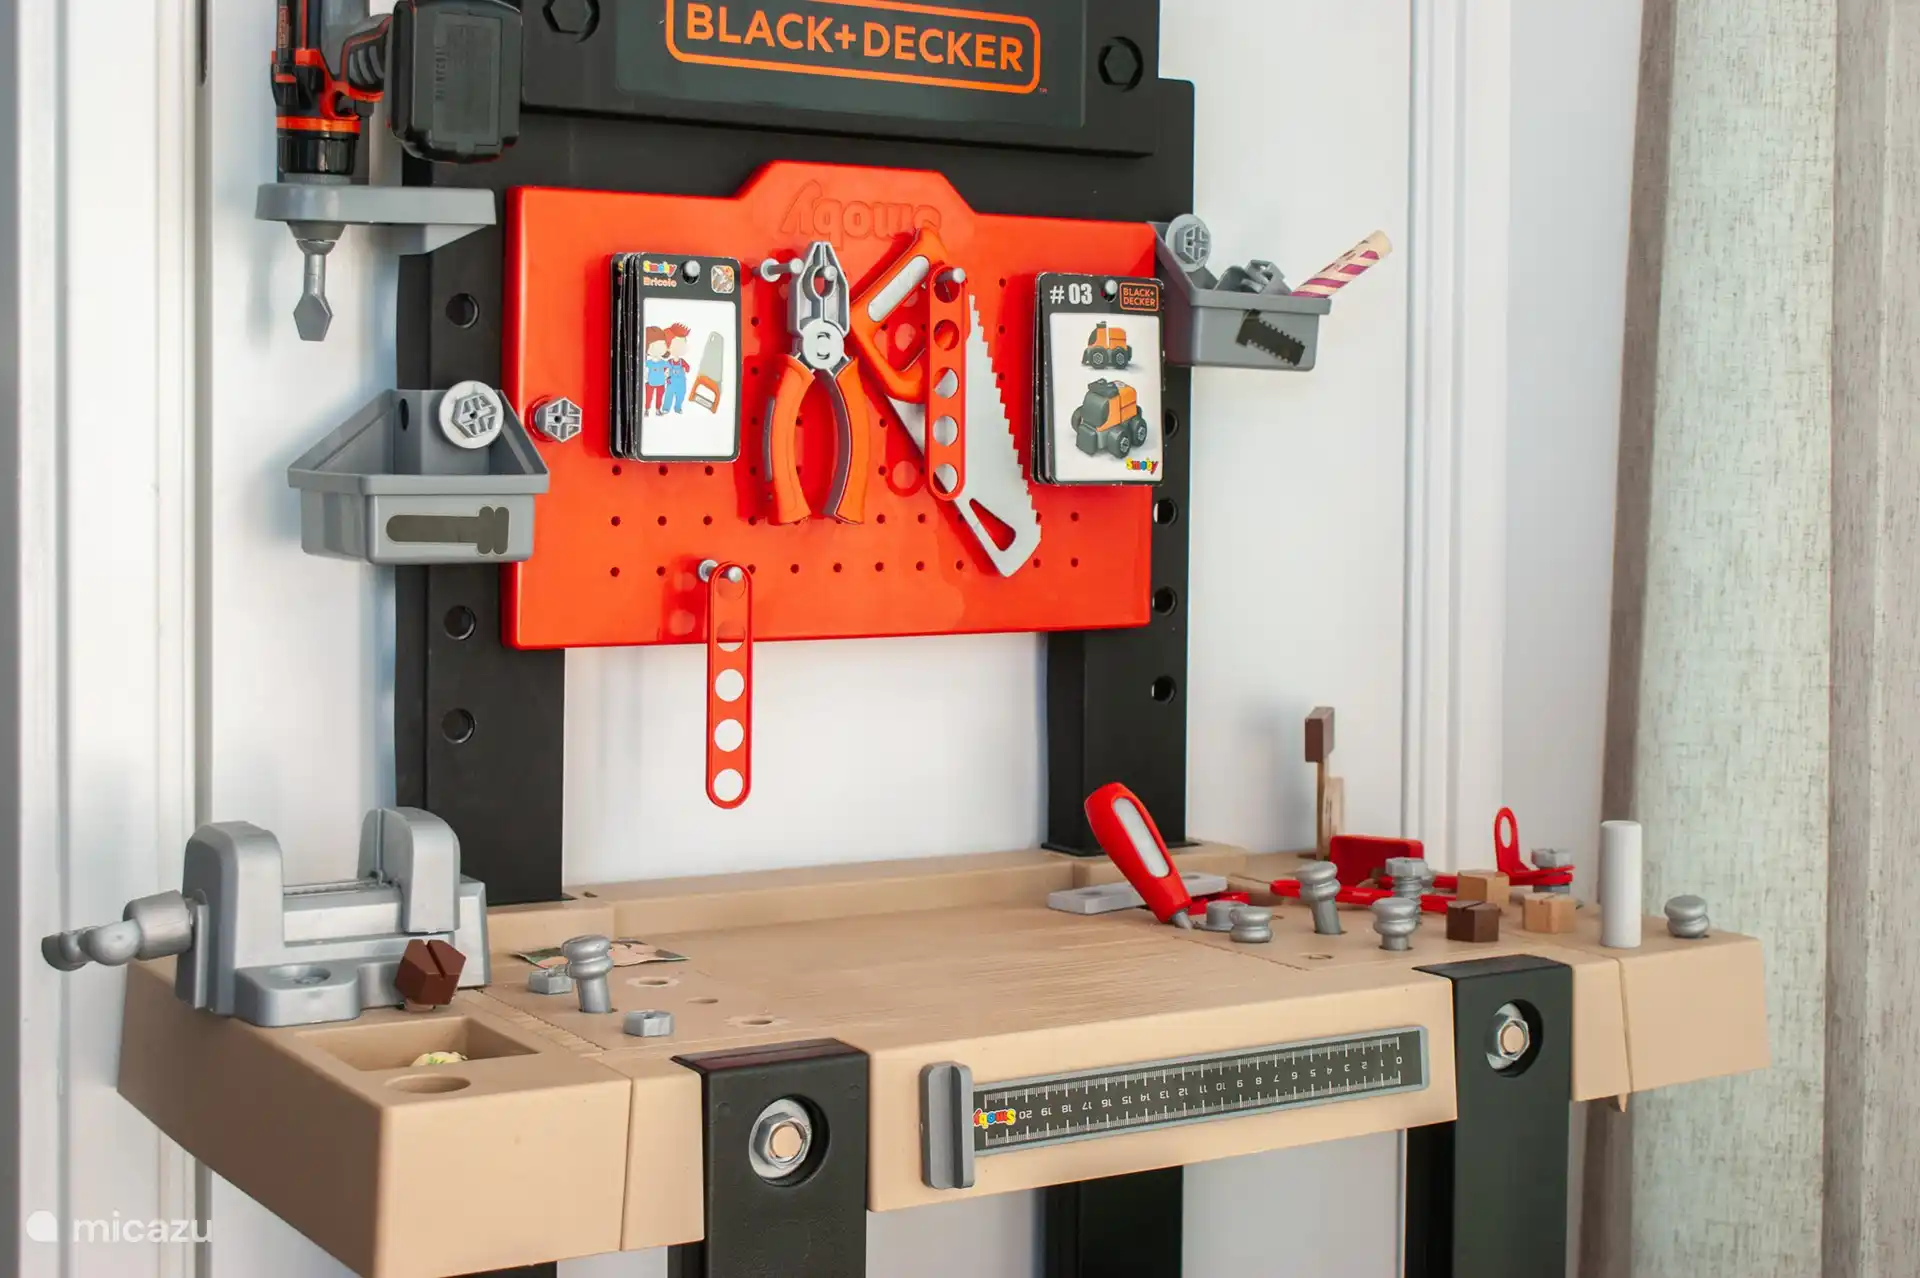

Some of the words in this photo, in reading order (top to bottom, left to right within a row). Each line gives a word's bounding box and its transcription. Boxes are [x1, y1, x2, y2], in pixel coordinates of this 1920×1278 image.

[686, 3, 1024, 72] BLACK+DECKER
[1050, 285, 1065, 304] #
[1068, 283, 1093, 305] 03
[1123, 287, 1155, 298] BLACK+
[1123, 297, 1155, 307] DECKER
[1125, 457, 1158, 474] Smoby
[1381, 1059, 1385, 1067] 1
[1396, 1056, 1402, 1064] 0
[1344, 1064, 1350, 1072] 3
[1361, 1061, 1368, 1069] 2
[1291, 1071, 1298, 1080] 6
[1310, 1069, 1316, 1077] 5
[1327, 1067, 1333, 1075] 4
[1255, 1077, 1262, 1085] 8
[1273, 1074, 1280, 1082] 7
[1216, 1082, 1226, 1091] 10
[1236, 1079, 1243, 1088] 9
[1178, 1088, 1188, 1096] 12
[1200, 1085, 1207, 1094] 11
[1140, 1093, 1151, 1102] 14
[1160, 1090, 1169, 1099] 13
[1101, 1099, 1112, 1108] 16
[1122, 1096, 1132, 1104] 15
[1062, 1104, 1072, 1113] 18
[1082, 1101, 1092, 1110] 17
[1019, 1110, 1032, 1119] 20
[1041, 1107, 1052, 1116] 19
[972, 1108, 1016, 1129] Smoby
